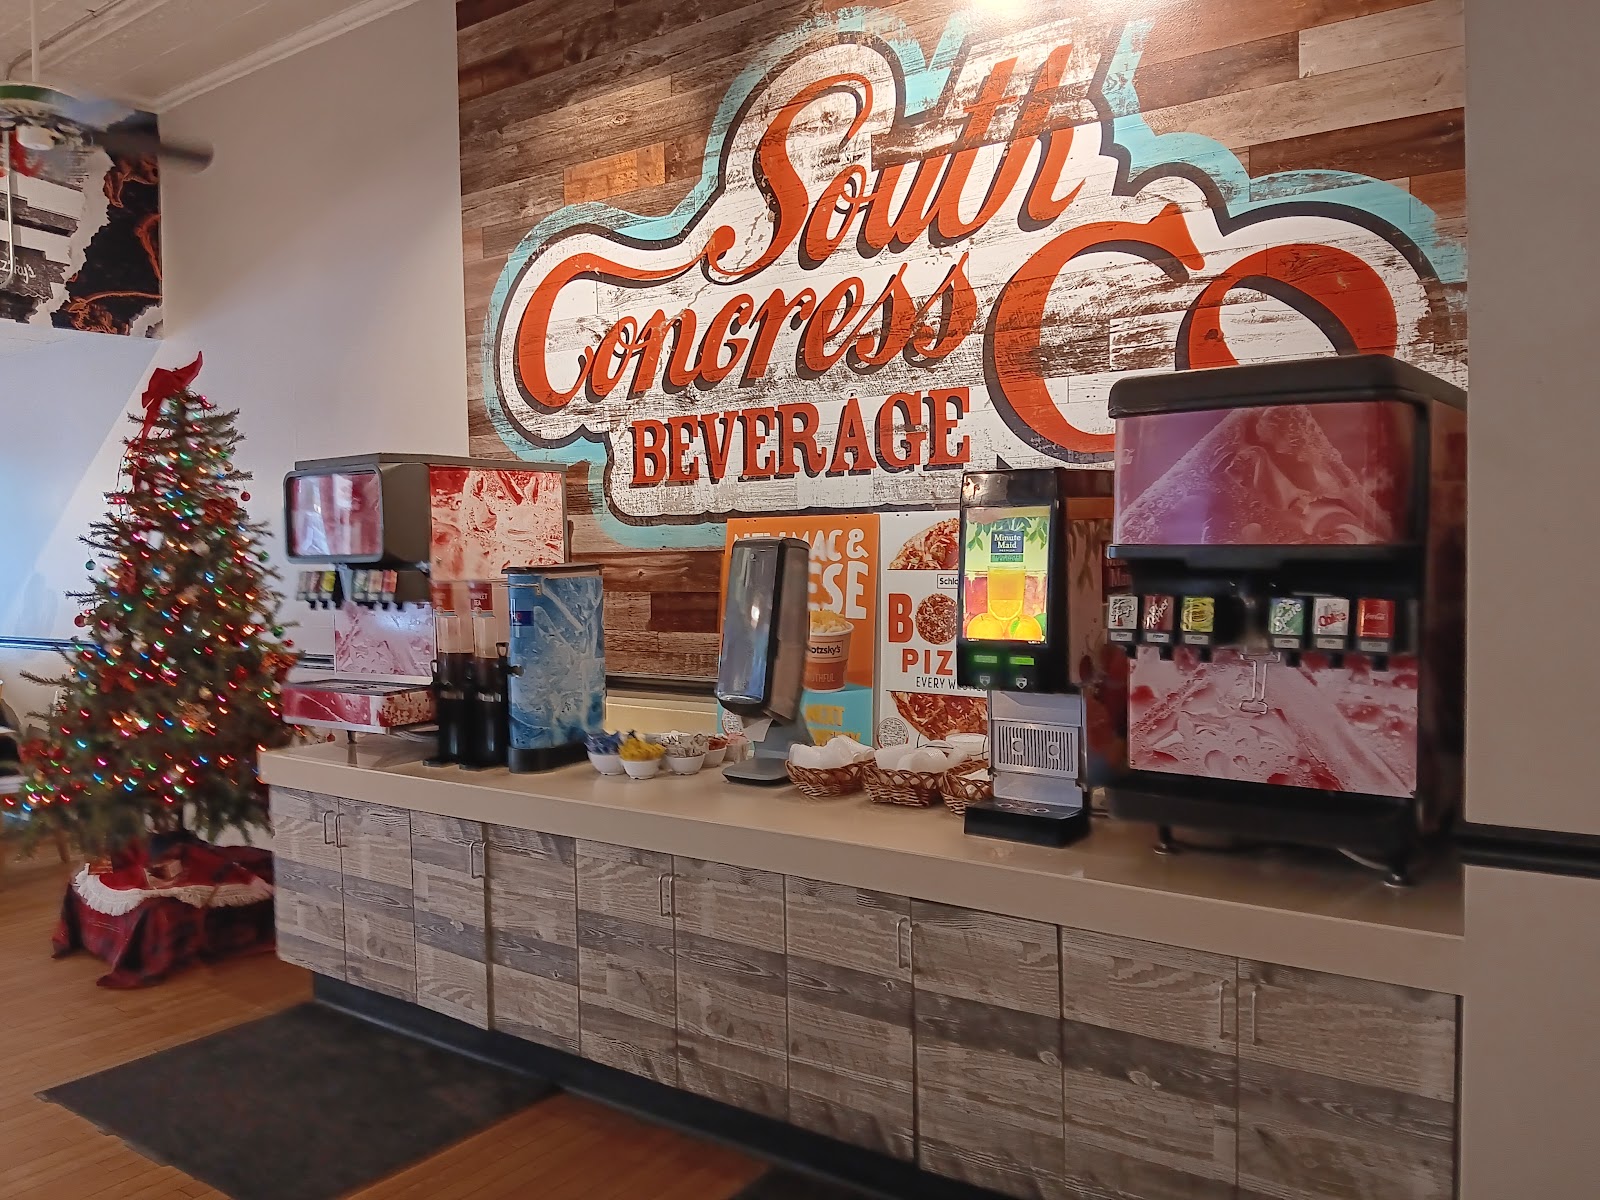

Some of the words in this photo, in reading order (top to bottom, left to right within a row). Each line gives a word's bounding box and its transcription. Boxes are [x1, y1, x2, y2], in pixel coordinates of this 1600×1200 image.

[704, 43, 1086, 280] South
[512, 250, 978, 412] Congress
[630, 387, 970, 489] BEVERAGE
[846, 528, 869, 559] &
[994, 533, 1022, 541] Minute
[997, 540, 1018, 549] Maid
[902, 648, 953, 676] PIZ
[916, 676, 945, 688] EVERY
